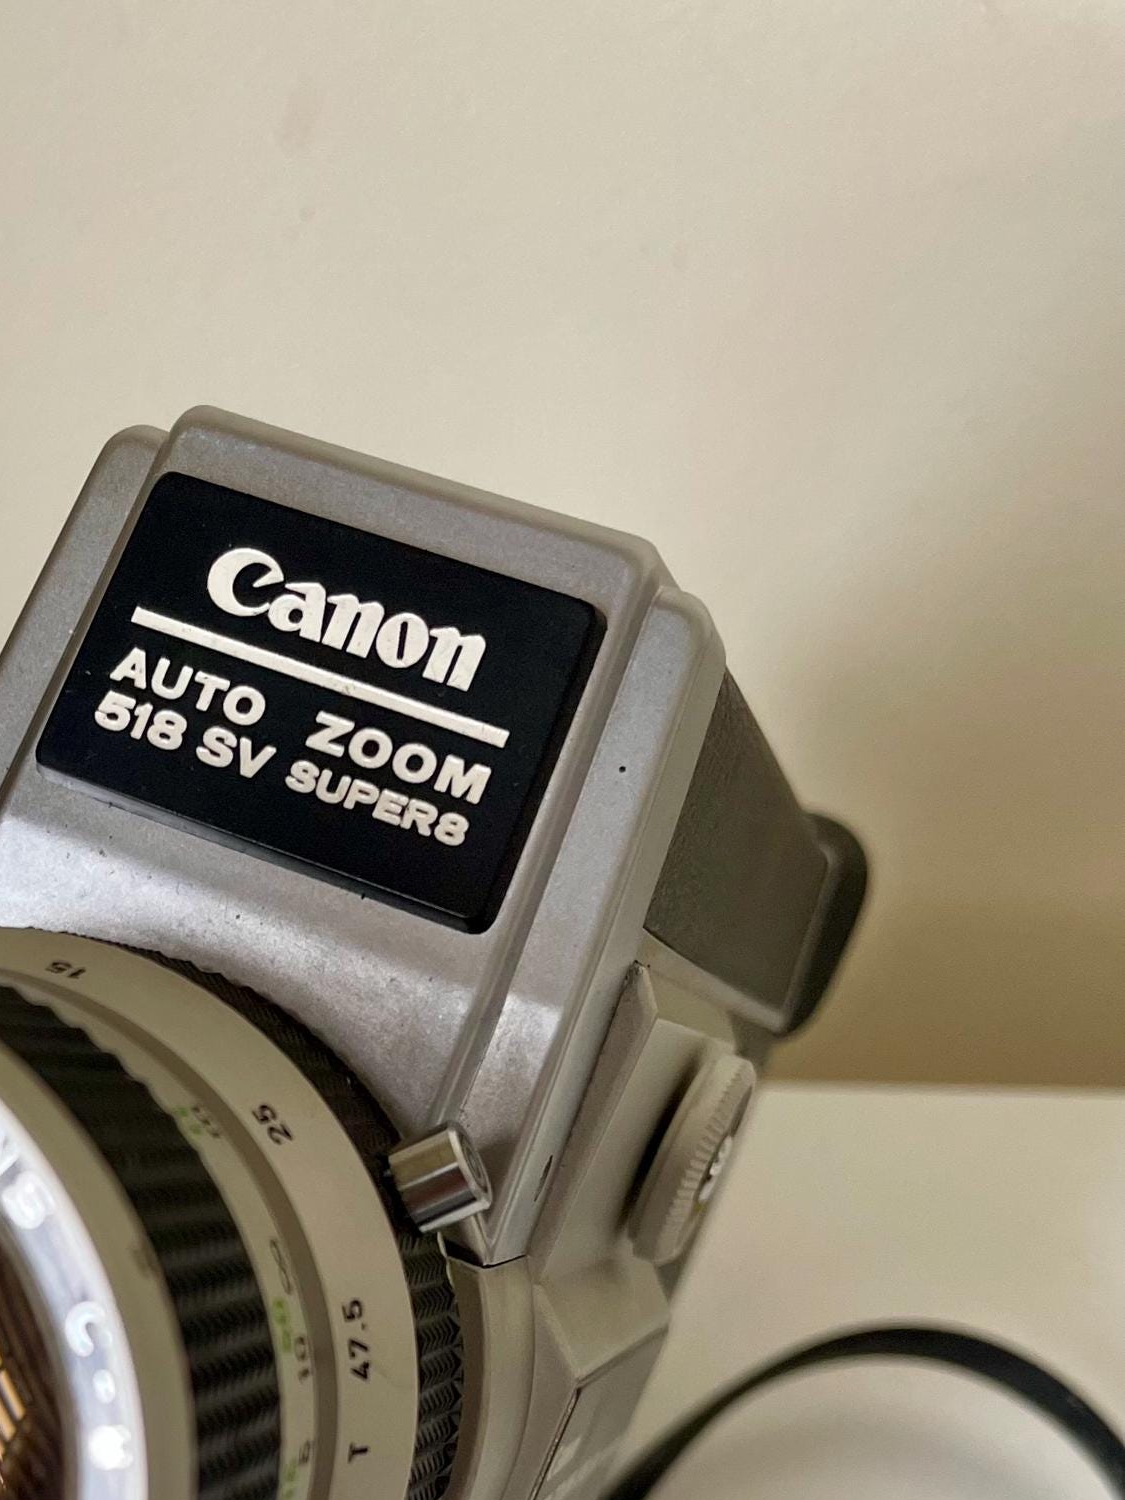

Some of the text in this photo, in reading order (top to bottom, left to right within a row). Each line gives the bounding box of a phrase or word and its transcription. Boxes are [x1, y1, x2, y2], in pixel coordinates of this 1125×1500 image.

[207, 547, 486, 692] Canon
[94, 691, 188, 751] 518
[196, 726, 276, 779] SV
[110, 647, 492, 805] AUTO ZOOM
[45, 961, 86, 980] 15
[252, 1104, 294, 1146] 25
[341, 1297, 371, 1382] 47.5
[346, 1441, 370, 1465] T
